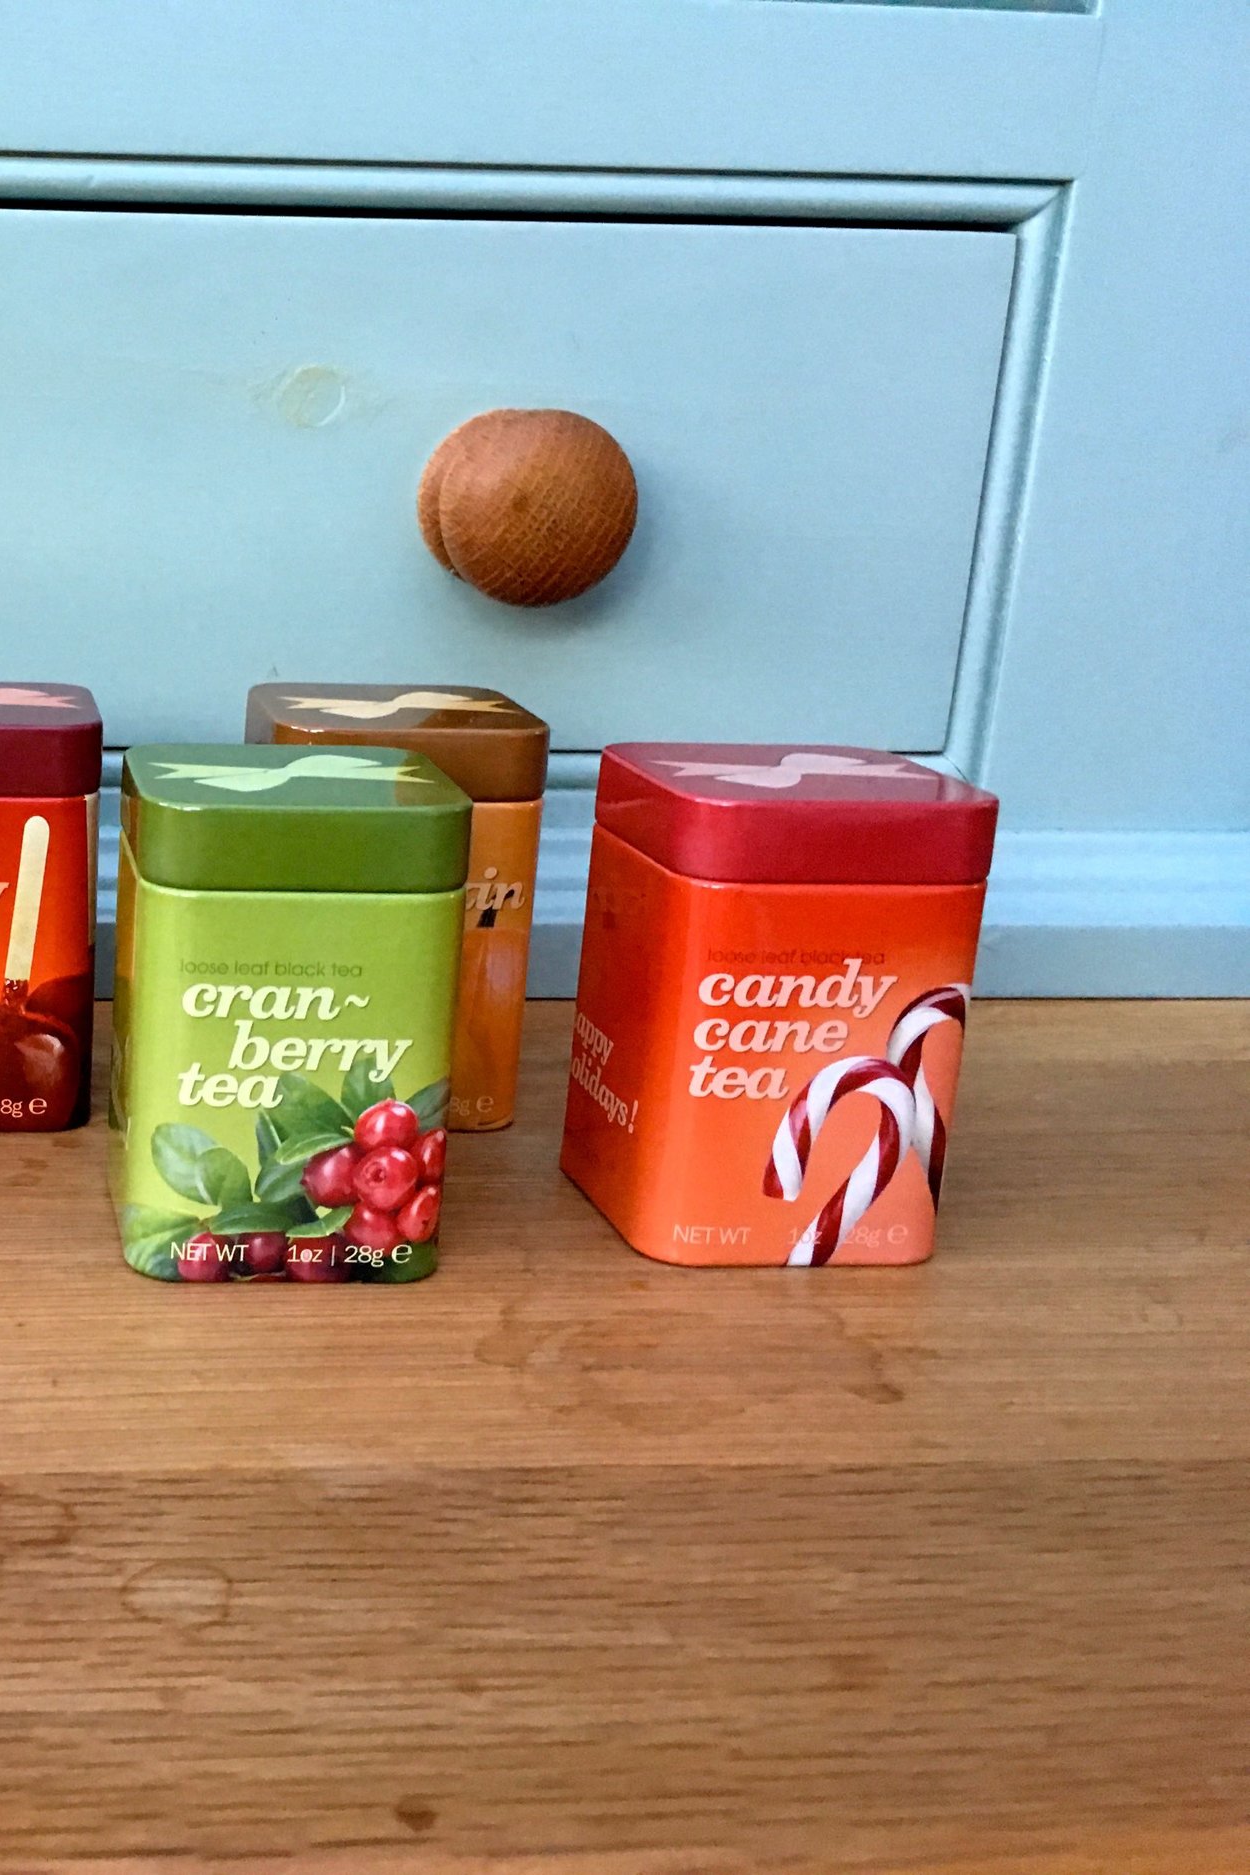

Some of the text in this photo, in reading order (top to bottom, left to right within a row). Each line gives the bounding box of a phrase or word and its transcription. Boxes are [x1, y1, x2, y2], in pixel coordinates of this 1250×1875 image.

[178, 958, 363, 978] loose leaf black tea
[708, 948, 755, 964] loose
[697, 958, 898, 1018] candy
[227, 1019, 412, 1083] berry
[575, 1009, 614, 1066] appy
[693, 1014, 848, 1054] cane
[176, 1061, 283, 1109] tea
[571, 1057, 638, 1134] olidays!
[688, 1056, 790, 1099] tea
[170, 1242, 213, 1261] NET
[215, 1244, 249, 1262] WT
[287, 1244, 322, 1263] 1oz
[344, 1243, 384, 1267] 28g
[672, 1224, 714, 1244] NET
[718, 1227, 751, 1245] WT
